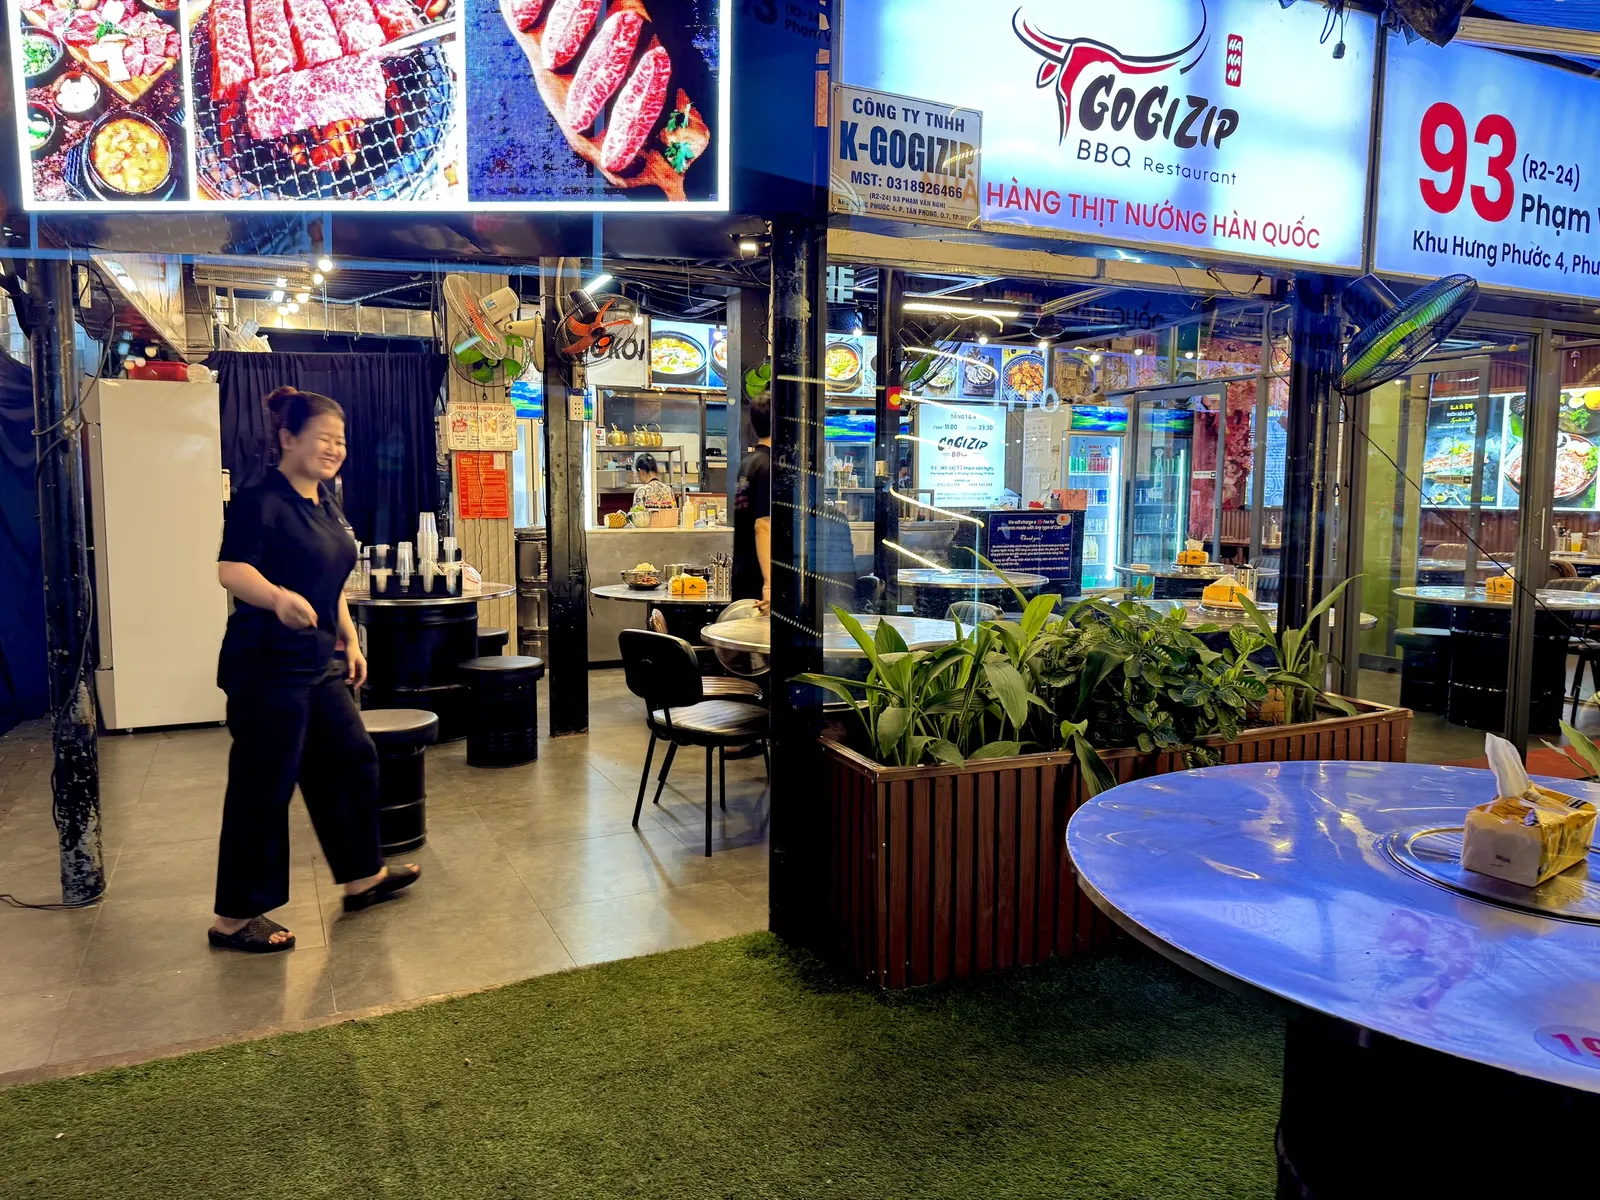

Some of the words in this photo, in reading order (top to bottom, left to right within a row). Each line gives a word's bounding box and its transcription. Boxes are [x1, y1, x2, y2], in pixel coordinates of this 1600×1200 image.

[1227, 53, 1241, 66] NA
[1229, 38, 1242, 51] HA
[1227, 69, 1240, 82] NI
[852, 96, 897, 120] CÔNG
[902, 107, 920, 124] TY
[925, 112, 965, 132] TNHH
[1078, 74, 1240, 150] GOGIZIP
[839, 120, 974, 179] K-GOGIZIP
[1077, 139, 1131, 168] BBQ
[1143, 157, 1237, 185] Restaurant
[1419, 101, 1517, 223] 93
[850, 170, 882, 188] MST:
[886, 176, 963, 199] 0318926466
[1522, 153, 1580, 192] (R2-24)
[869, 192, 892, 202] (R2-24)
[892, 195, 901, 203] 93
[901, 197, 919, 206] PHẠM
[986, 176, 1062, 215] HÀNG
[1068, 193, 1119, 228] THỊT
[1125, 200, 1208, 235] NƯỚNG
[1213, 209, 1258, 241] HÀN
[1262, 215, 1321, 249] QUỐC
[1520, 193, 1591, 237] Phạm
[1412, 229, 1448, 254] Khu
[1452, 235, 1498, 267] Hưng
[1501, 243, 1551, 269] Phước
[1555, 251, 1568, 275] 4,
